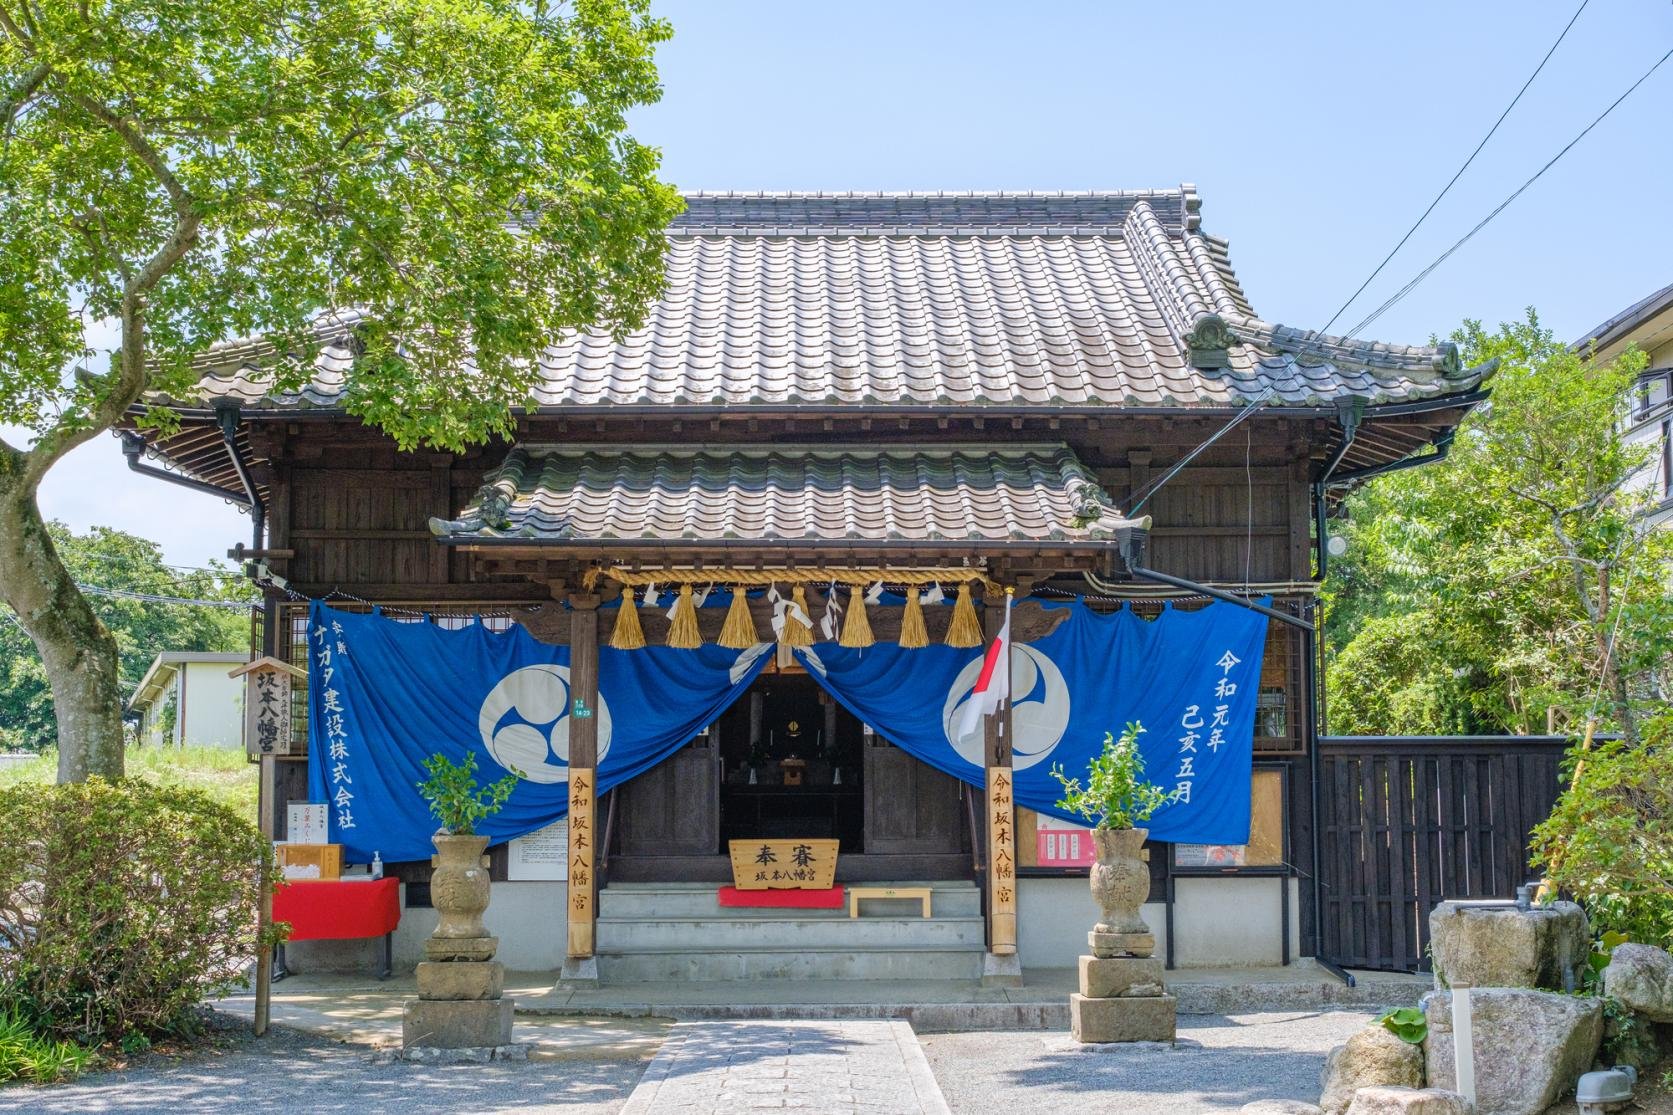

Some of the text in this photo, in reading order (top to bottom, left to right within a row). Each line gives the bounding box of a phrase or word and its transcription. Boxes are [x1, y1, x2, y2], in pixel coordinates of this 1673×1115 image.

[257, 671, 280, 752] 坂本八幡宮
[313, 624, 356, 830] ナガタ建設株式会社
[1207, 650, 1241, 753] 令和元年
[1174, 704, 1204, 804] 己亥五月
[754, 868, 816, 882] 坂本八幡宮
